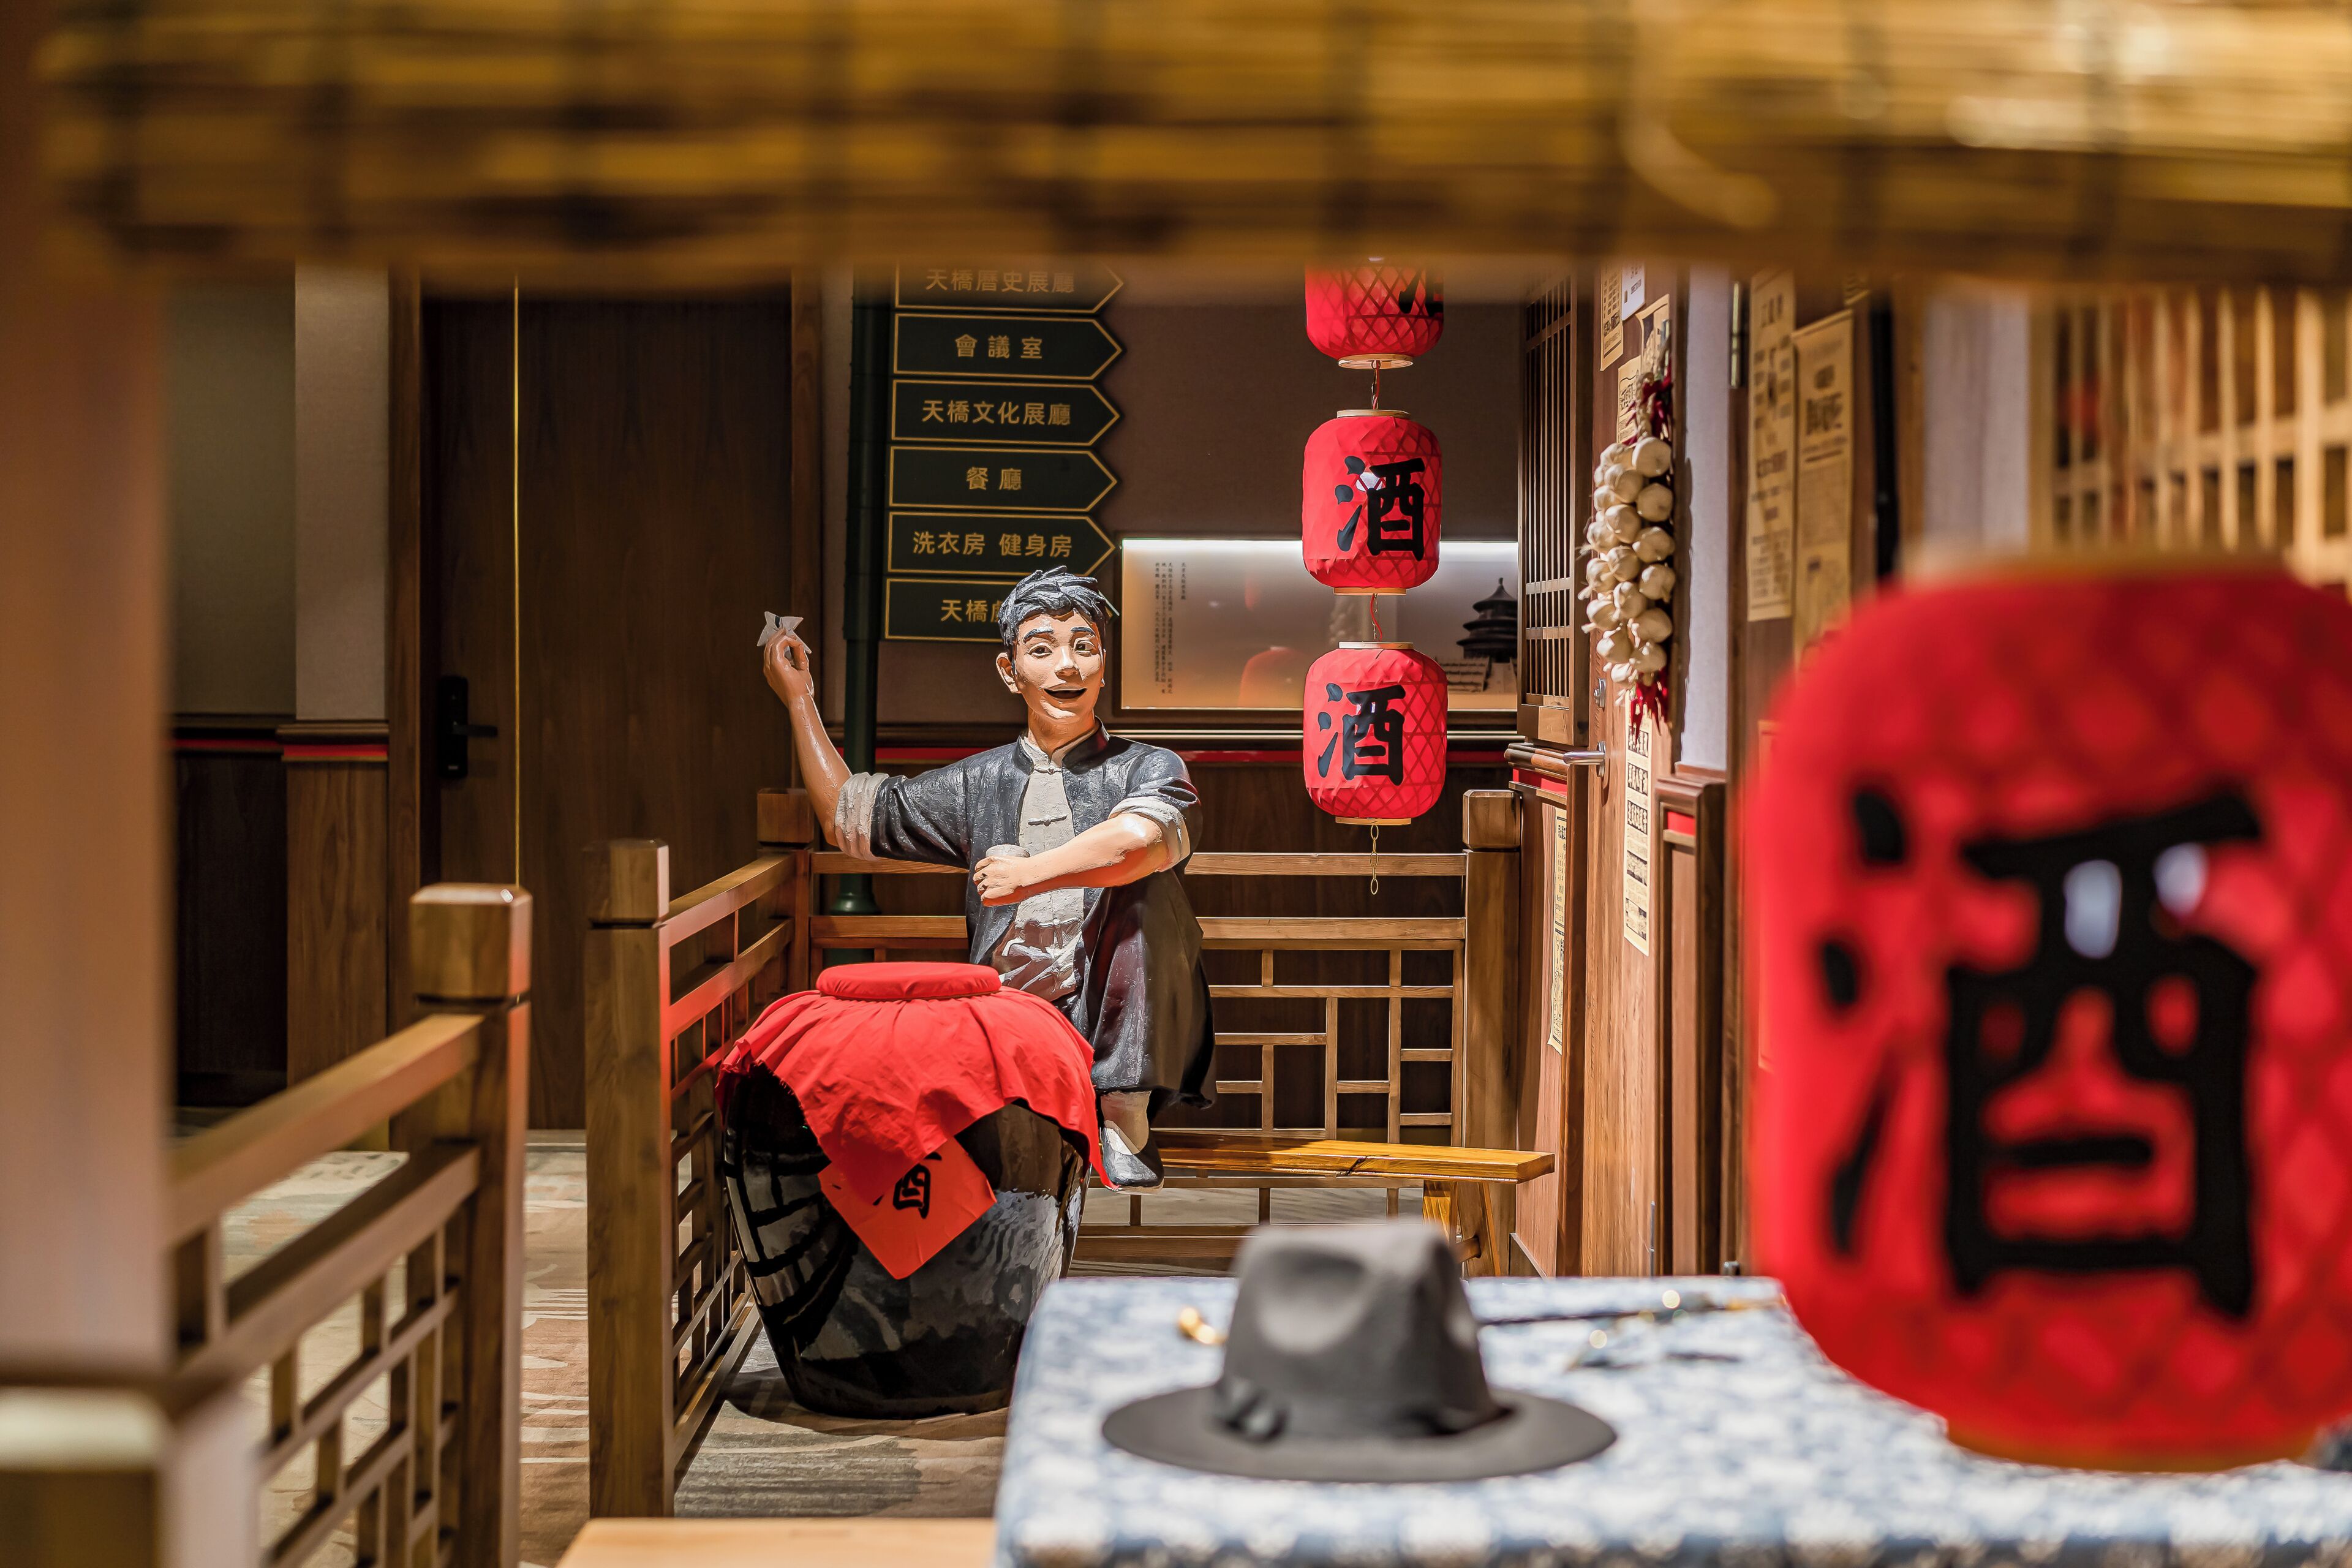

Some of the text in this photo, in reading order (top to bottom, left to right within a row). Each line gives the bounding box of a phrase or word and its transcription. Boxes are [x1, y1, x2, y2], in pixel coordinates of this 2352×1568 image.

[954, 334, 1043, 360] 會議室
[922, 399, 1072, 426] 天橋文化展廳
[966, 467, 1022, 490] 餐廳
[1334, 455, 1425, 562] 酒
[913, 531, 1072, 557] 洗衣房 健身房
[1317, 683, 1406, 786] 酒
[1817, 773, 2264, 1322] 酒
